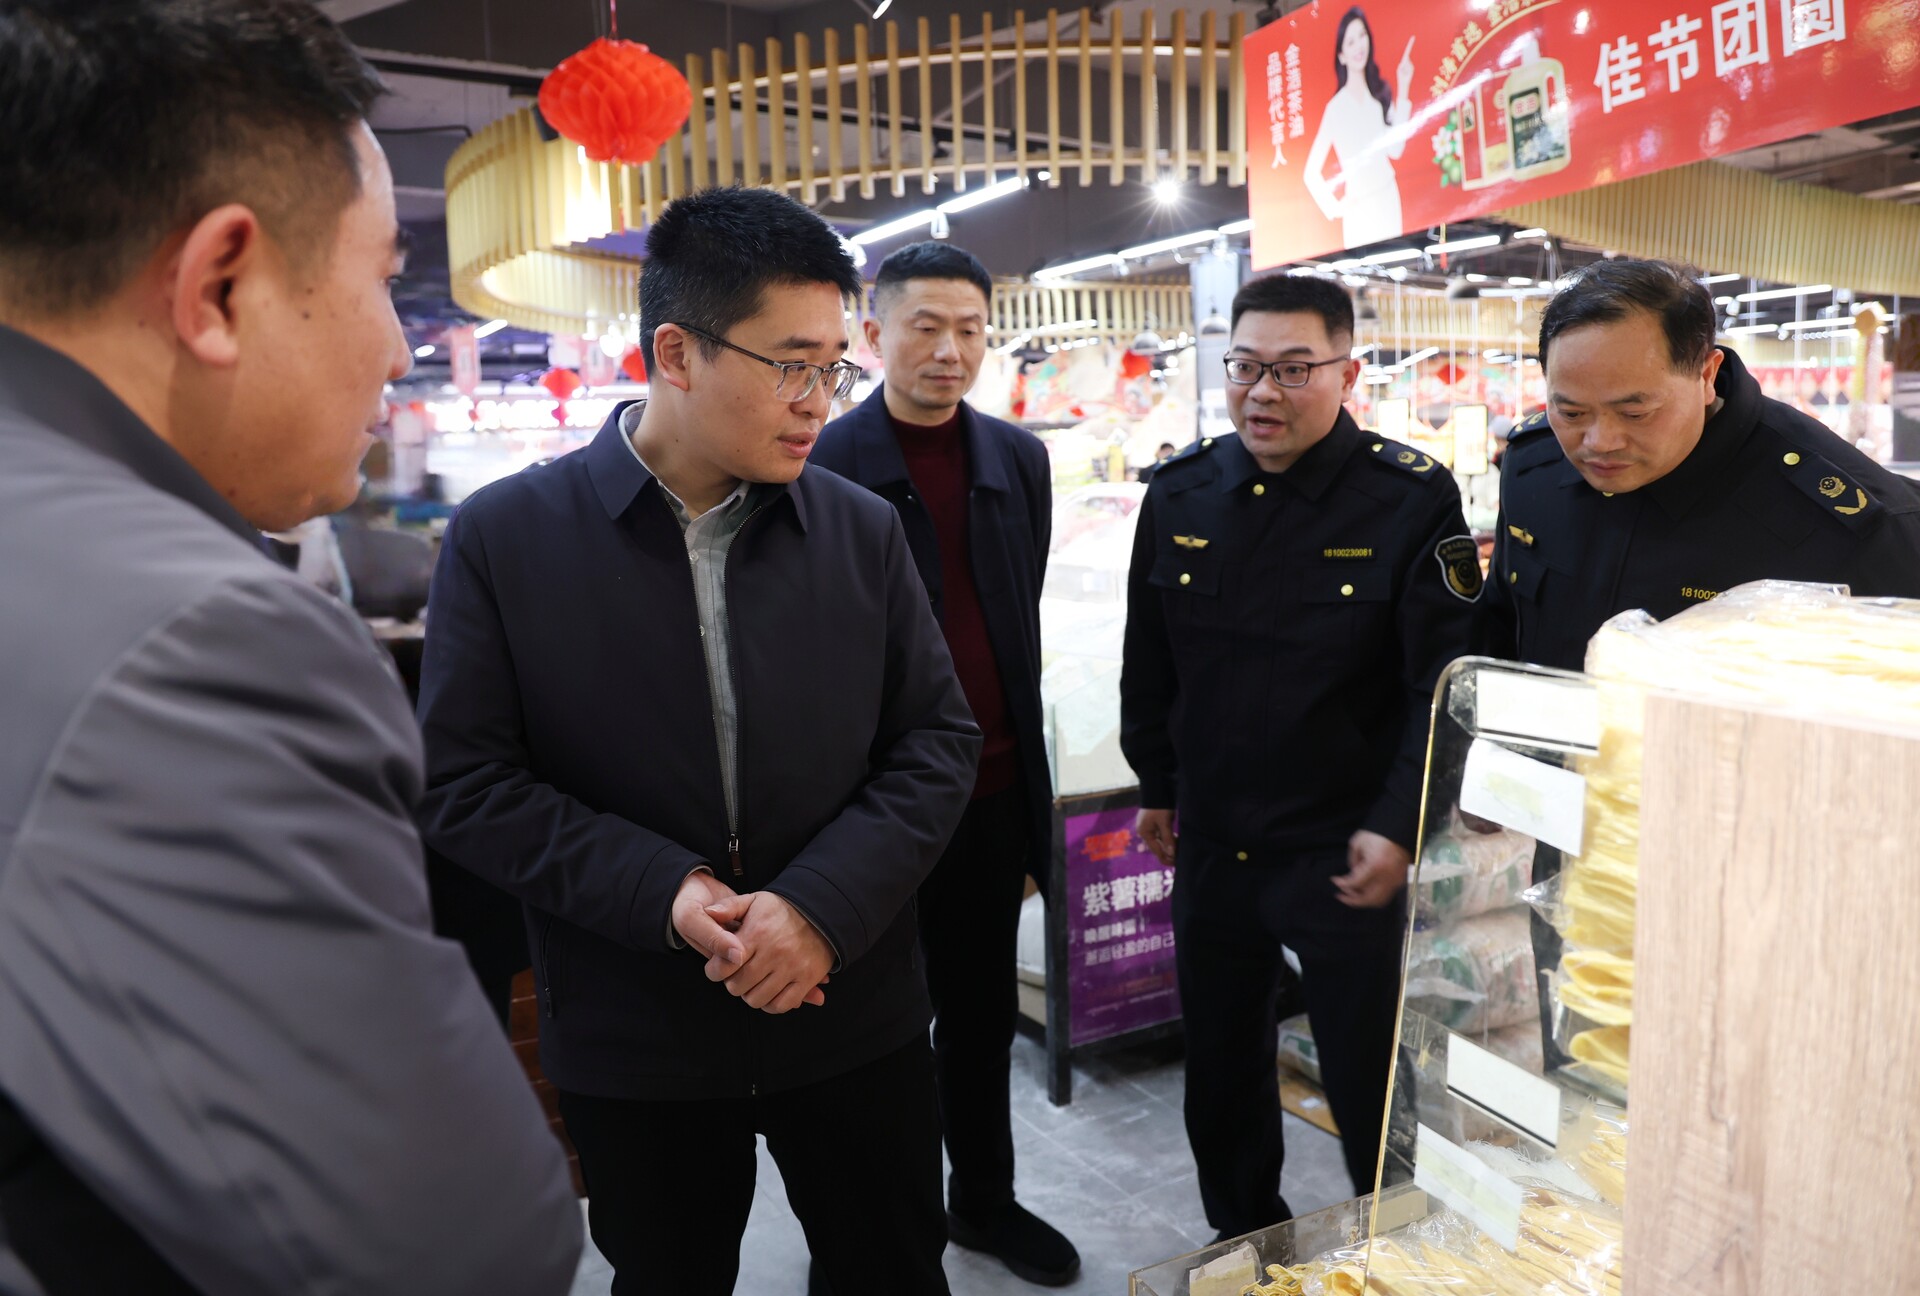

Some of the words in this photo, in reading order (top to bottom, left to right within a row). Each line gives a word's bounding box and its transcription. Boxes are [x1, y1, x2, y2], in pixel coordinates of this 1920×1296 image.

[1267, 51, 1288, 169] 品牌代言人
[1593, 0, 1847, 114] 佳节团圆
[1681, 587, 1717, 600] 181002
